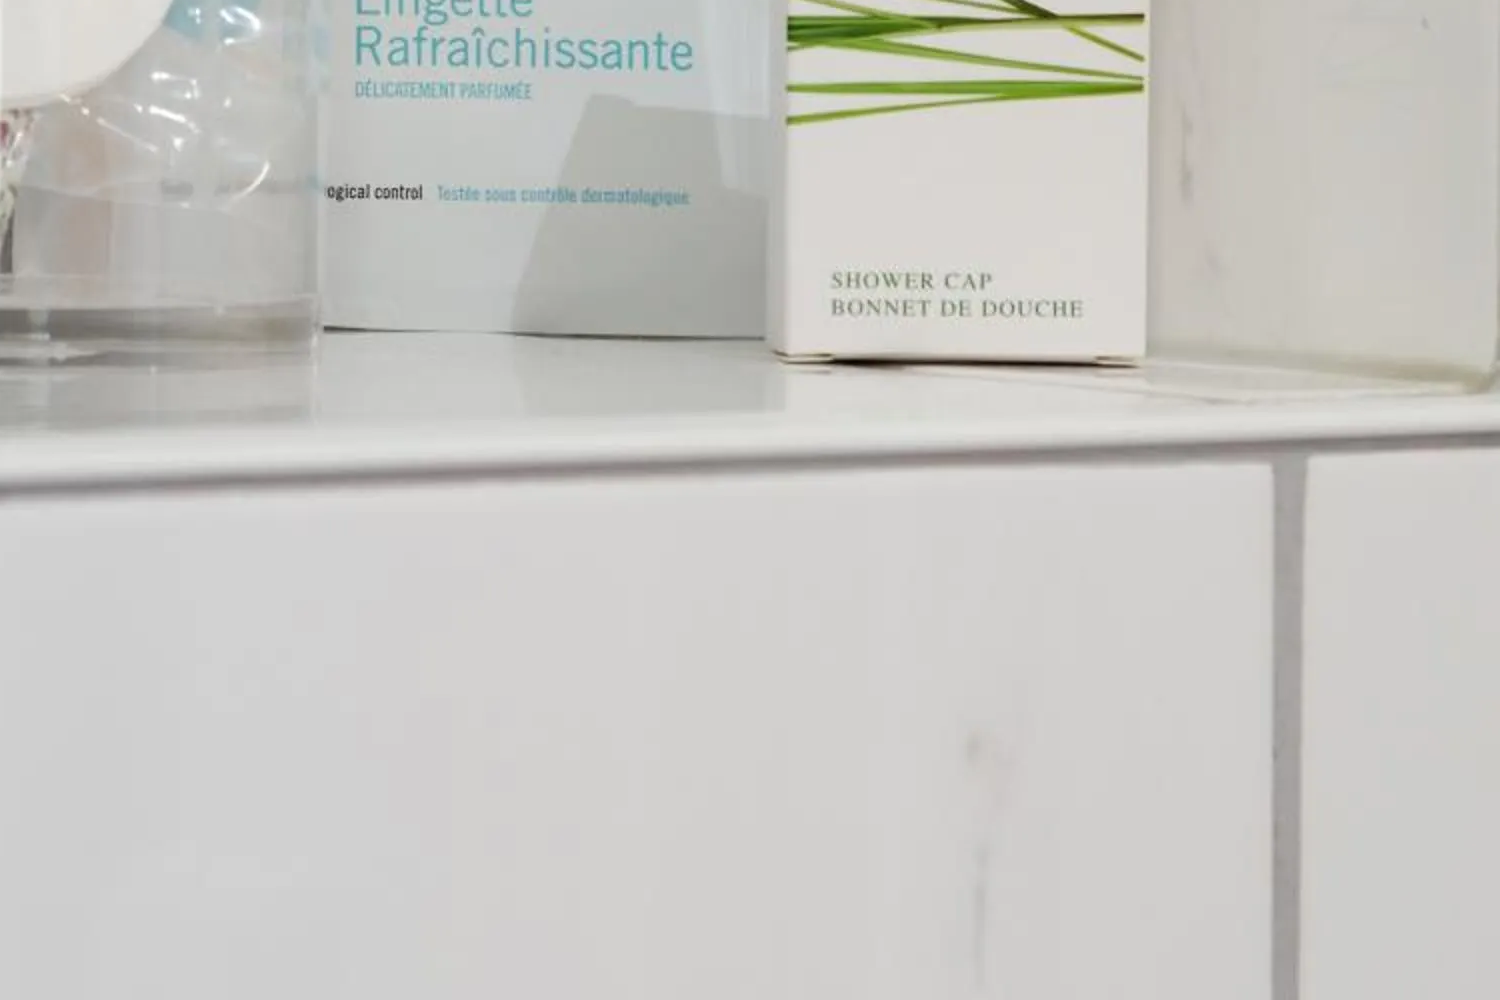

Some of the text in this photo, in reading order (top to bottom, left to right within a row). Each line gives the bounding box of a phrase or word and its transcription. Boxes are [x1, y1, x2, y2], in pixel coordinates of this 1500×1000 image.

[355, 25, 693, 72] Rafraîchissante
[374, 184, 423, 201] control
[831, 271, 992, 290] SHOWER CAP
[831, 298, 1083, 319] BONNET DE DOUCHE
